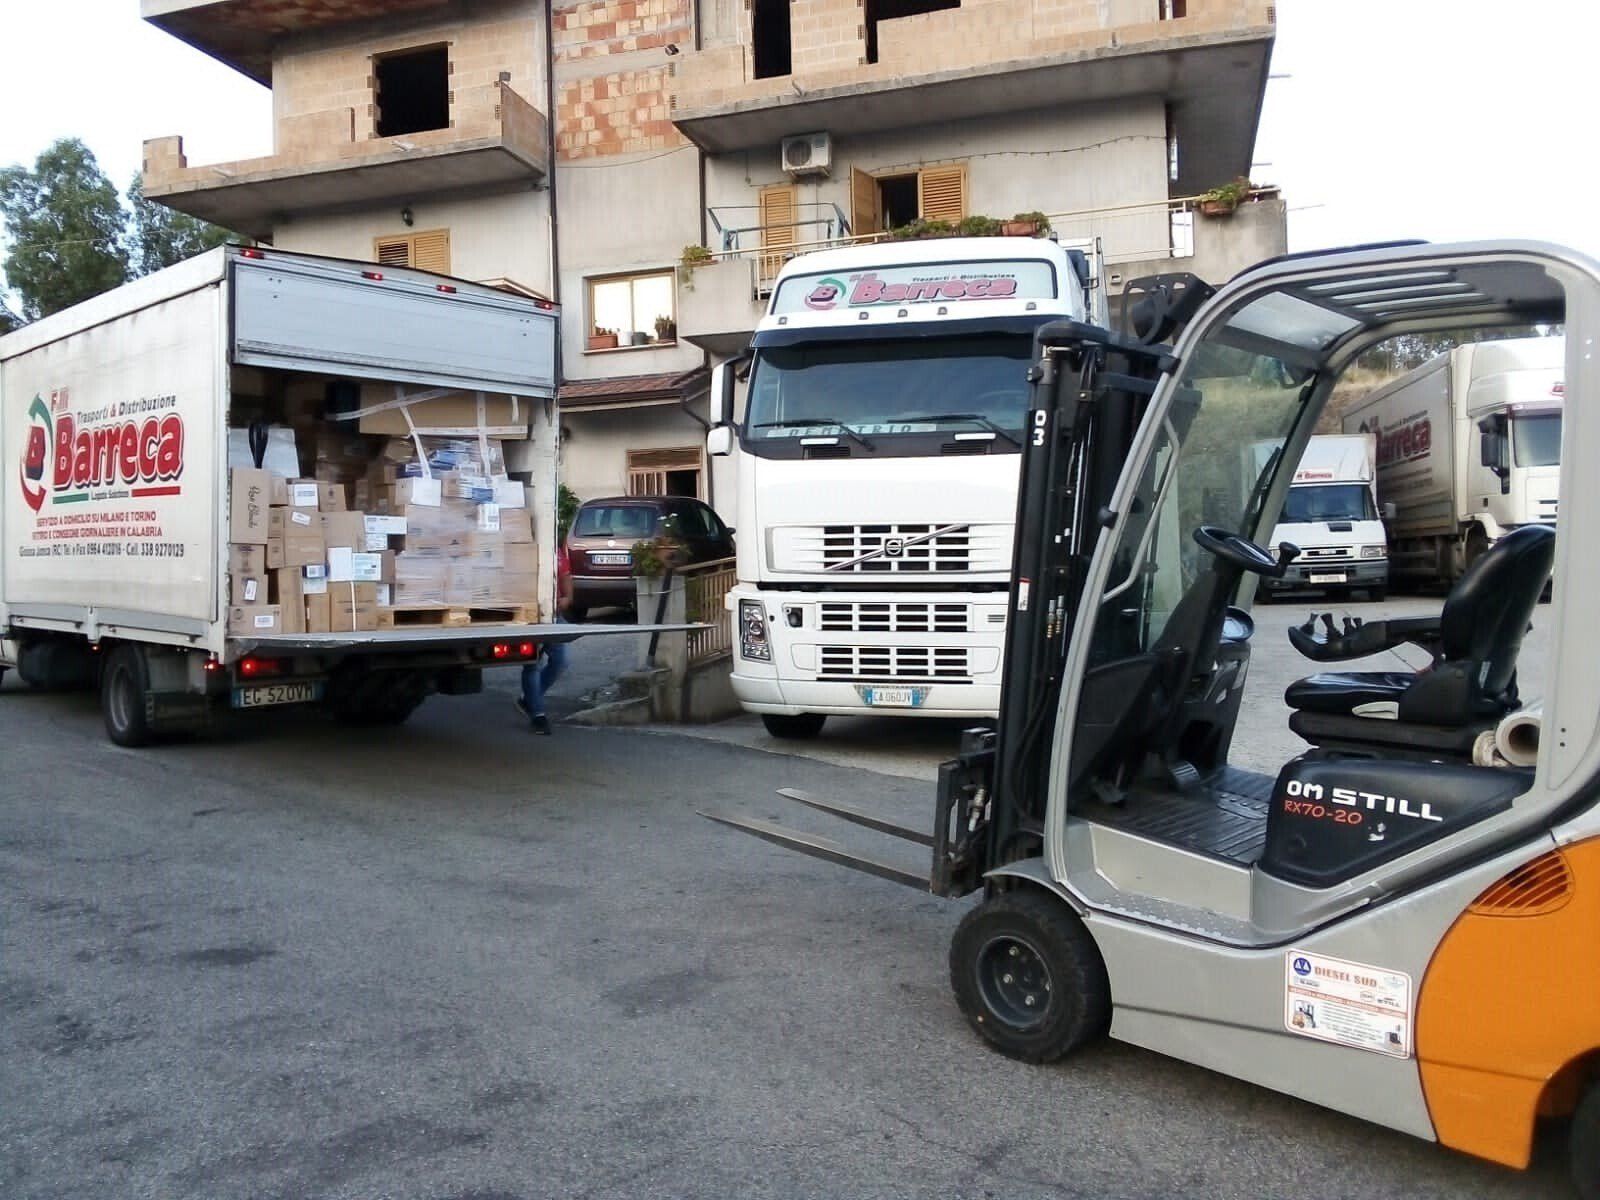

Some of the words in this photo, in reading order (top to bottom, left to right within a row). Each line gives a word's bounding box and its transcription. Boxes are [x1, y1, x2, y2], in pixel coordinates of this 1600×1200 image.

[849, 279, 1017, 304] Barreca
[77, 408, 108, 424] Trasporti
[110, 404, 116, 417] &
[119, 394, 176, 416] Distribuzione
[53, 412, 184, 491] Barreca
[91, 512, 99, 523] SU
[100, 511, 124, 522] MILANO
[130, 510, 156, 521] TORINO
[126, 526, 162, 536] CALABRIA
[141, 543, 153, 556] 338
[155, 543, 184, 557] 9270129
[1284, 800, 1363, 825] RX70-20
[1287, 780, 1323, 799] OM
[1332, 787, 1443, 822] STILL
[1314, 966, 1350, 982] DIESEL
[1354, 975, 1377, 988] SUD
